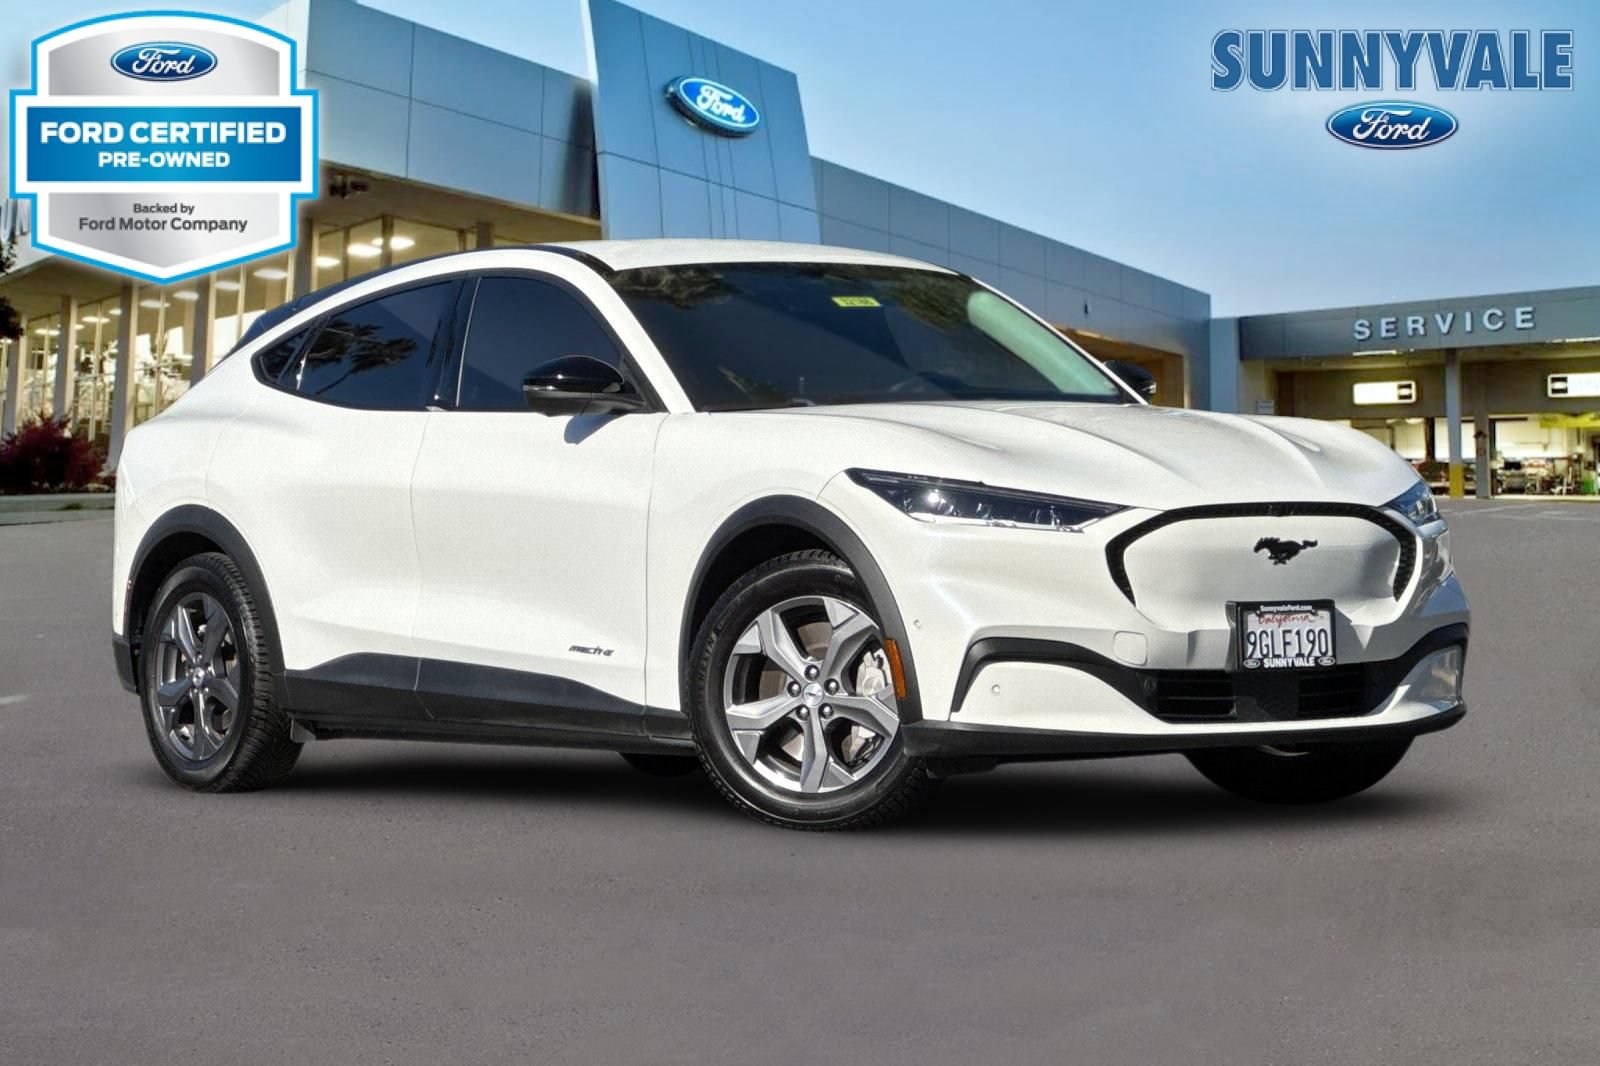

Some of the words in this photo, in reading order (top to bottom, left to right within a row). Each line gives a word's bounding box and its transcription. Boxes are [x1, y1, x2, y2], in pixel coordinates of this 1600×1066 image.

[697, 85, 746, 122] Ford
[1353, 306, 1536, 340] SERVICE
[1259, 613, 1315, 628] California
[1246, 628, 1328, 659] 9GLF190
[1263, 657, 1316, 668] SUNNYVALE
